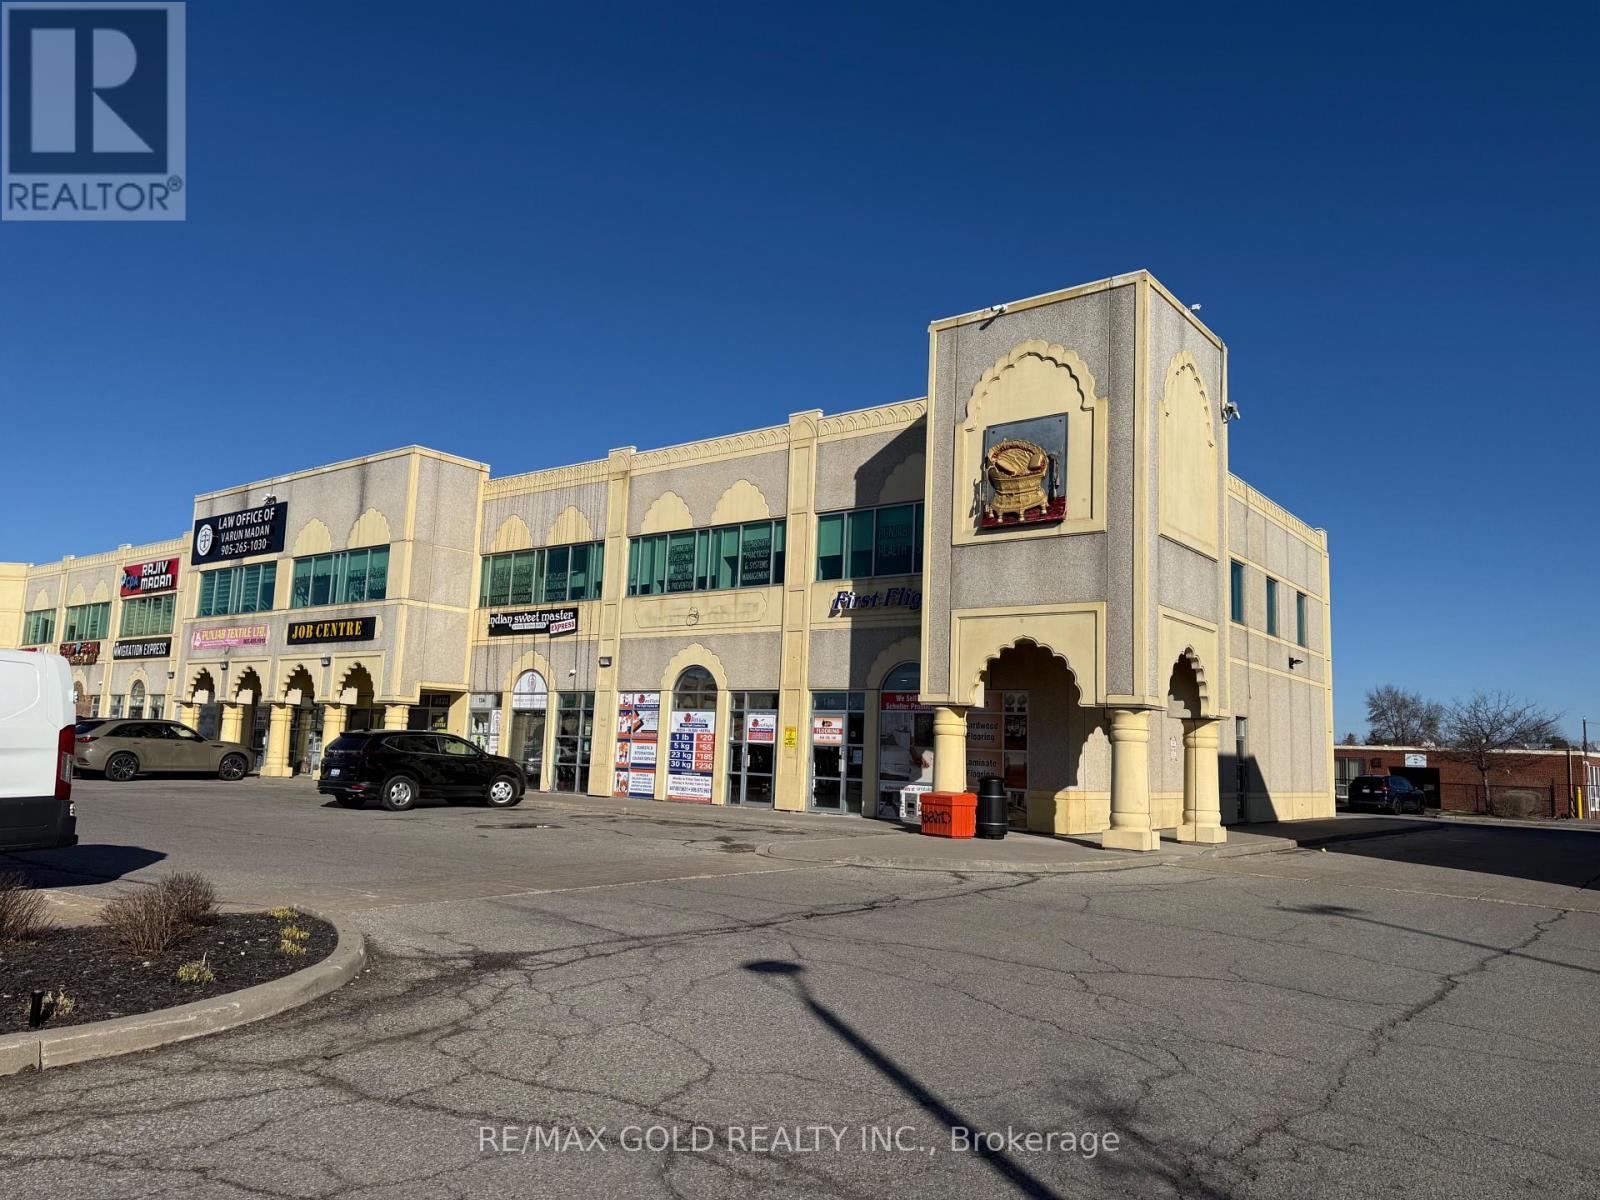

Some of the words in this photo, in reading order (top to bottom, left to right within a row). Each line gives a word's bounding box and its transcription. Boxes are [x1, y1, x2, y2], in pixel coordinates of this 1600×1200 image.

[218, 515, 236, 530] LAW
[235, 509, 263, 527] OFFICE
[263, 507, 276, 521] OF
[221, 529, 244, 543] VARUN
[244, 524, 271, 539] MADAN
[221, 538, 267, 556] 905-265-1030
[142, 560, 169, 577] RAJIV
[749, 560, 769, 570] SYSTEMS
[742, 570, 770, 581] MANAGEMENT
[140, 574, 173, 591] MADAN
[833, 590, 880, 610] First
[513, 610, 541, 624] sweet
[540, 608, 575, 625] master
[227, 626, 253, 639] TEXTILE
[292, 624, 314, 640] JOB
[315, 620, 363, 638] CENTRE
[550, 620, 576, 633] EXPRESS
[143, 642, 167, 656] EXPRESS
[896, 694, 903, 703] We
[907, 694, 919, 703] Sell
[968, 721, 998, 730] ardwood
[681, 733, 690, 741] lb
[681, 742, 690, 750] kg
[671, 751, 681, 759] 23
[682, 752, 692, 760] kg
[670, 760, 680, 768] 30
[681, 761, 691, 769] kg
[968, 758, 998, 768] aminate
